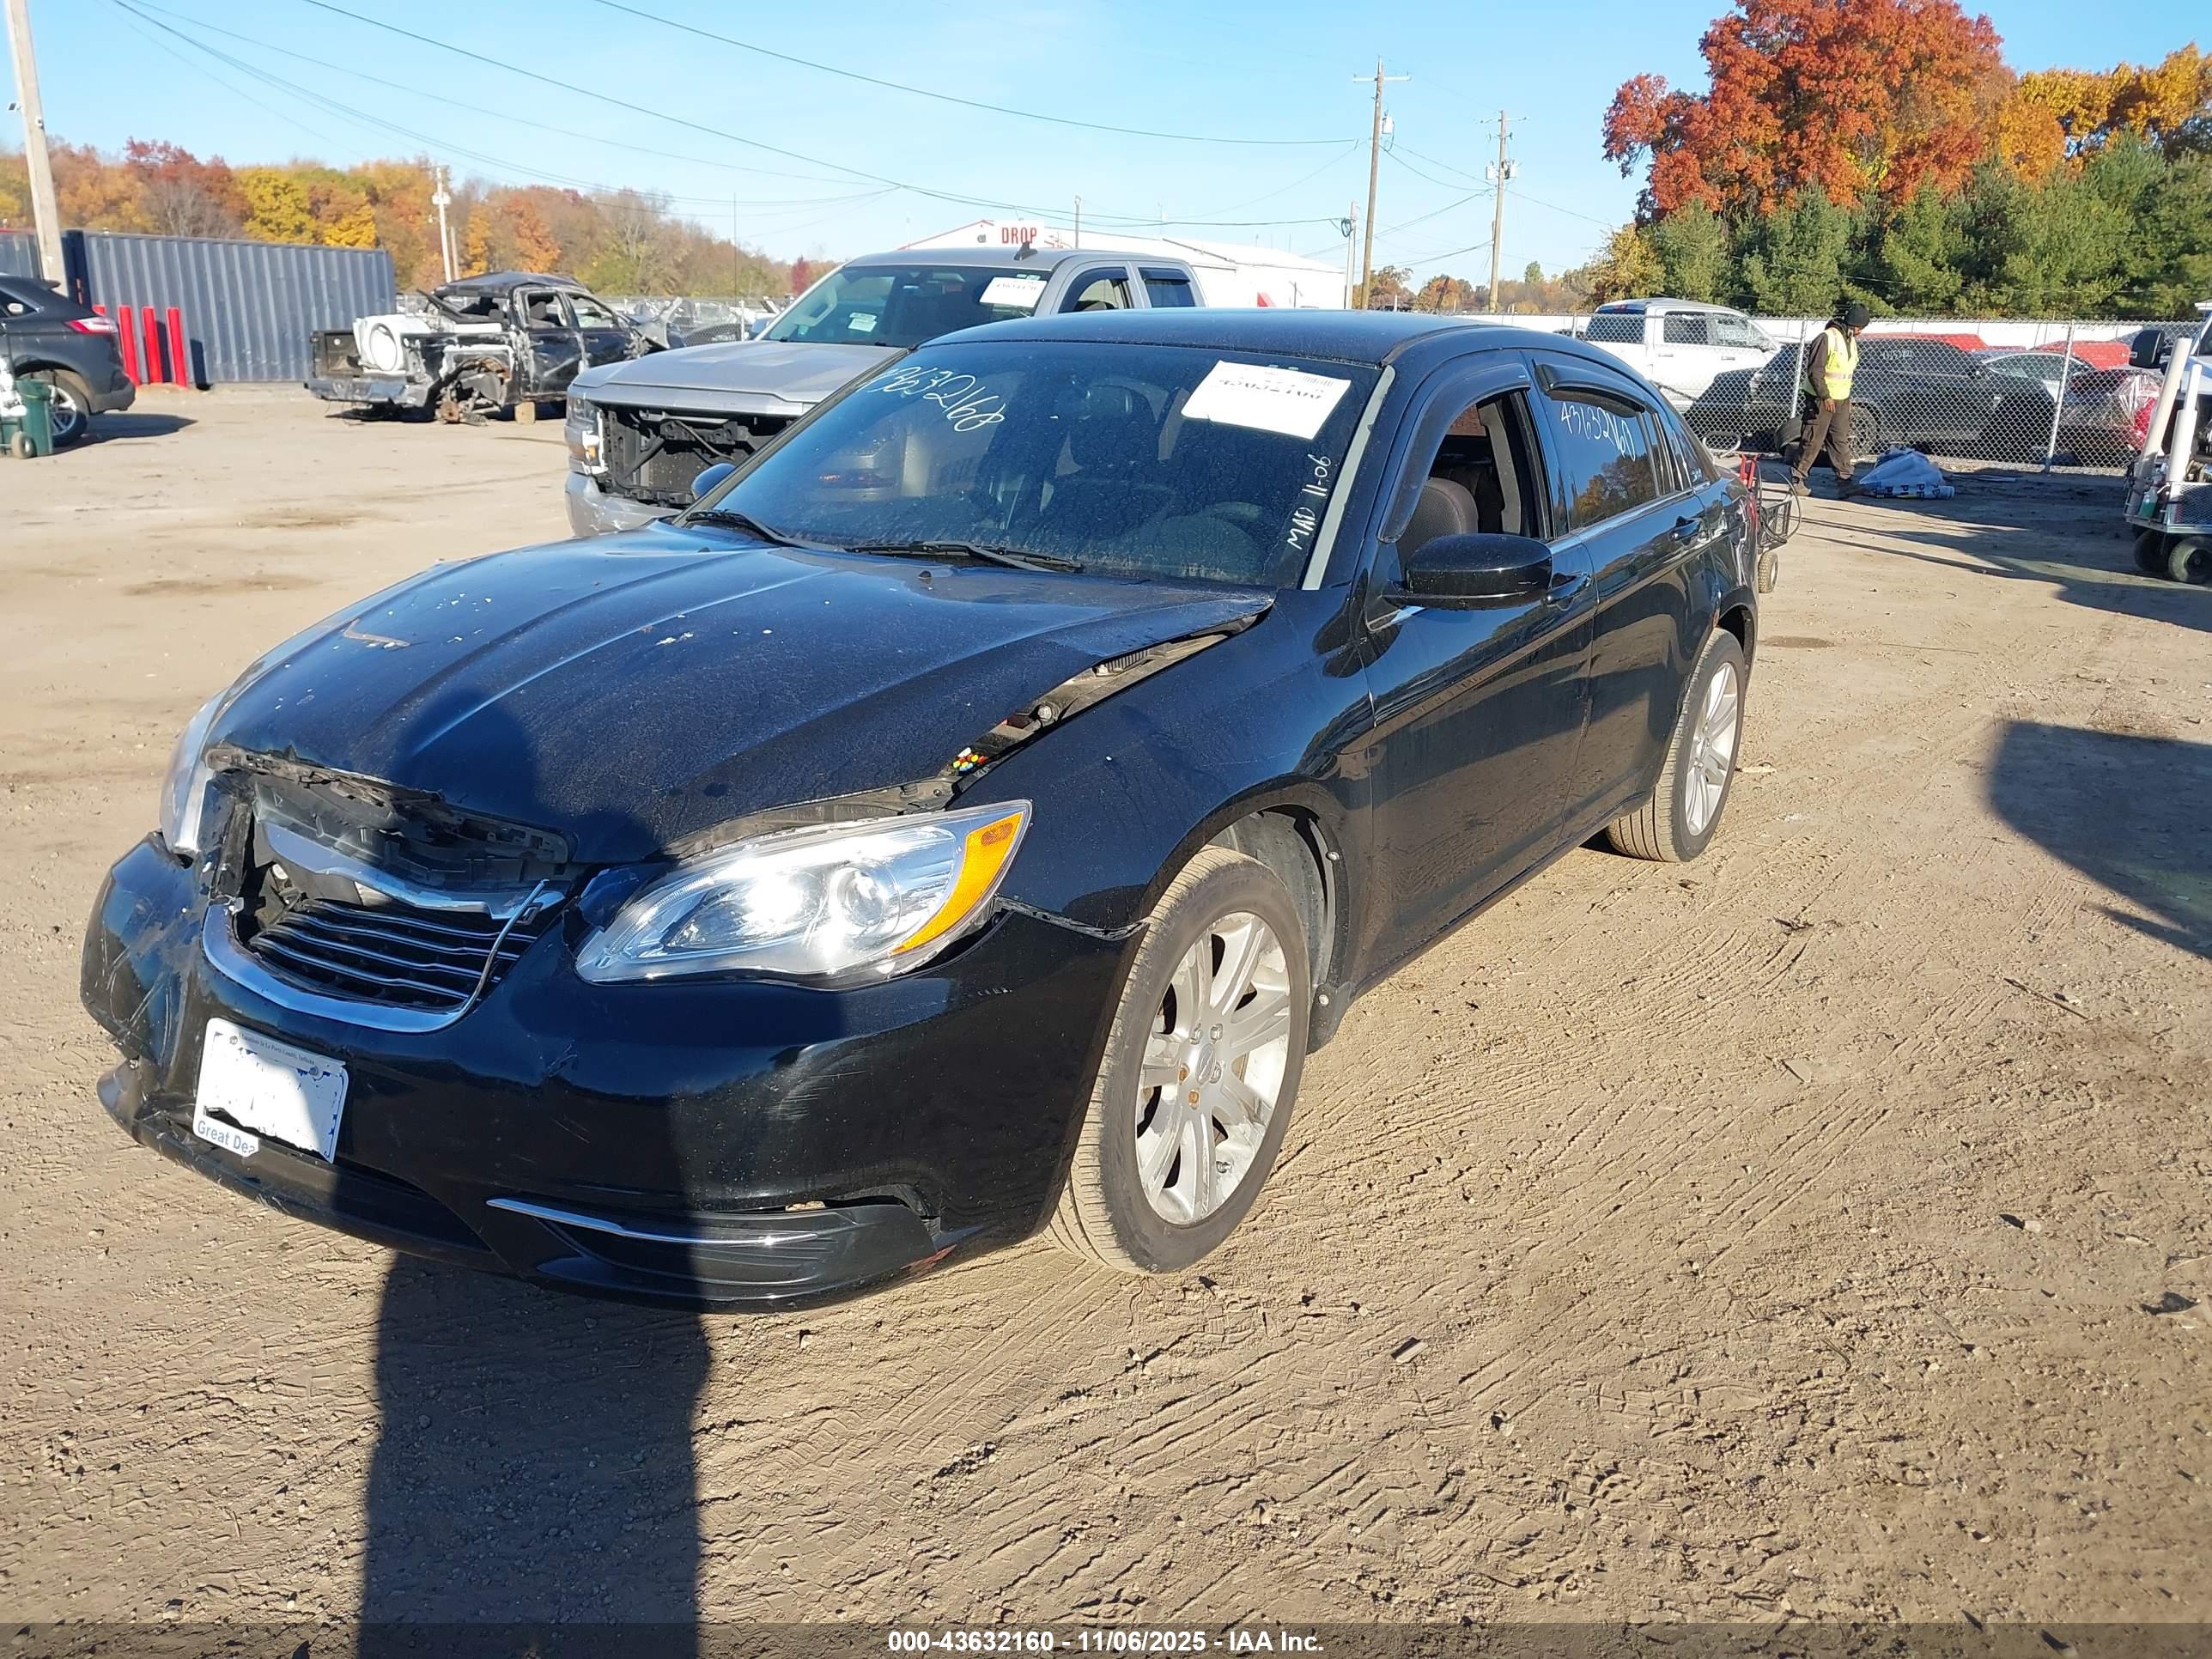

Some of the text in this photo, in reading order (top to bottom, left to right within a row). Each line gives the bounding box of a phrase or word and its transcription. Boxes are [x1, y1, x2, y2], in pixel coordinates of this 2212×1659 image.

[1001, 227, 1037, 244] DROP
[1560, 400, 1636, 462] 43632160
[1286, 453, 1332, 550] MAD 11-06
[197, 1120, 231, 1144] Great
